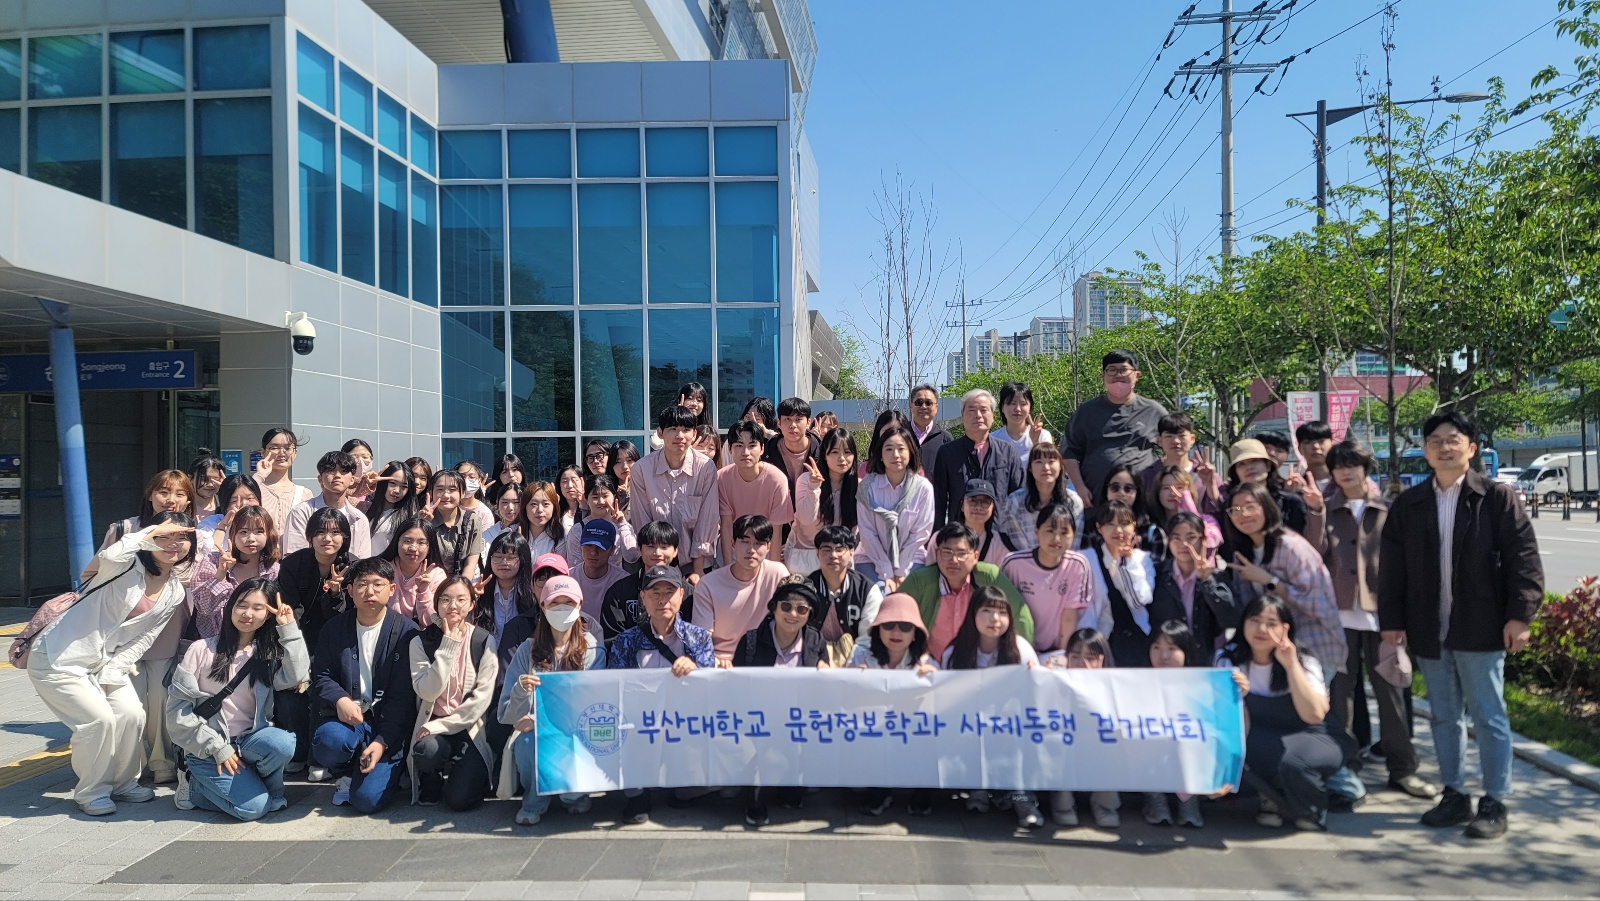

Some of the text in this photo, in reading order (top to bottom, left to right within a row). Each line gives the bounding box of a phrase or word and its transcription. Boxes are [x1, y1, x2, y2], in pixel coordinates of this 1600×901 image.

[81, 363, 126, 372] Songjeong
[149, 362, 170, 371] 출입구
[173, 361, 186, 378] 2
[637, 709, 771, 744] 부산대학교
[784, 707, 946, 744] 문헌정보학과
[960, 707, 1077, 745] 사제동행
[1090, 712, 1207, 744] 걷기대회
